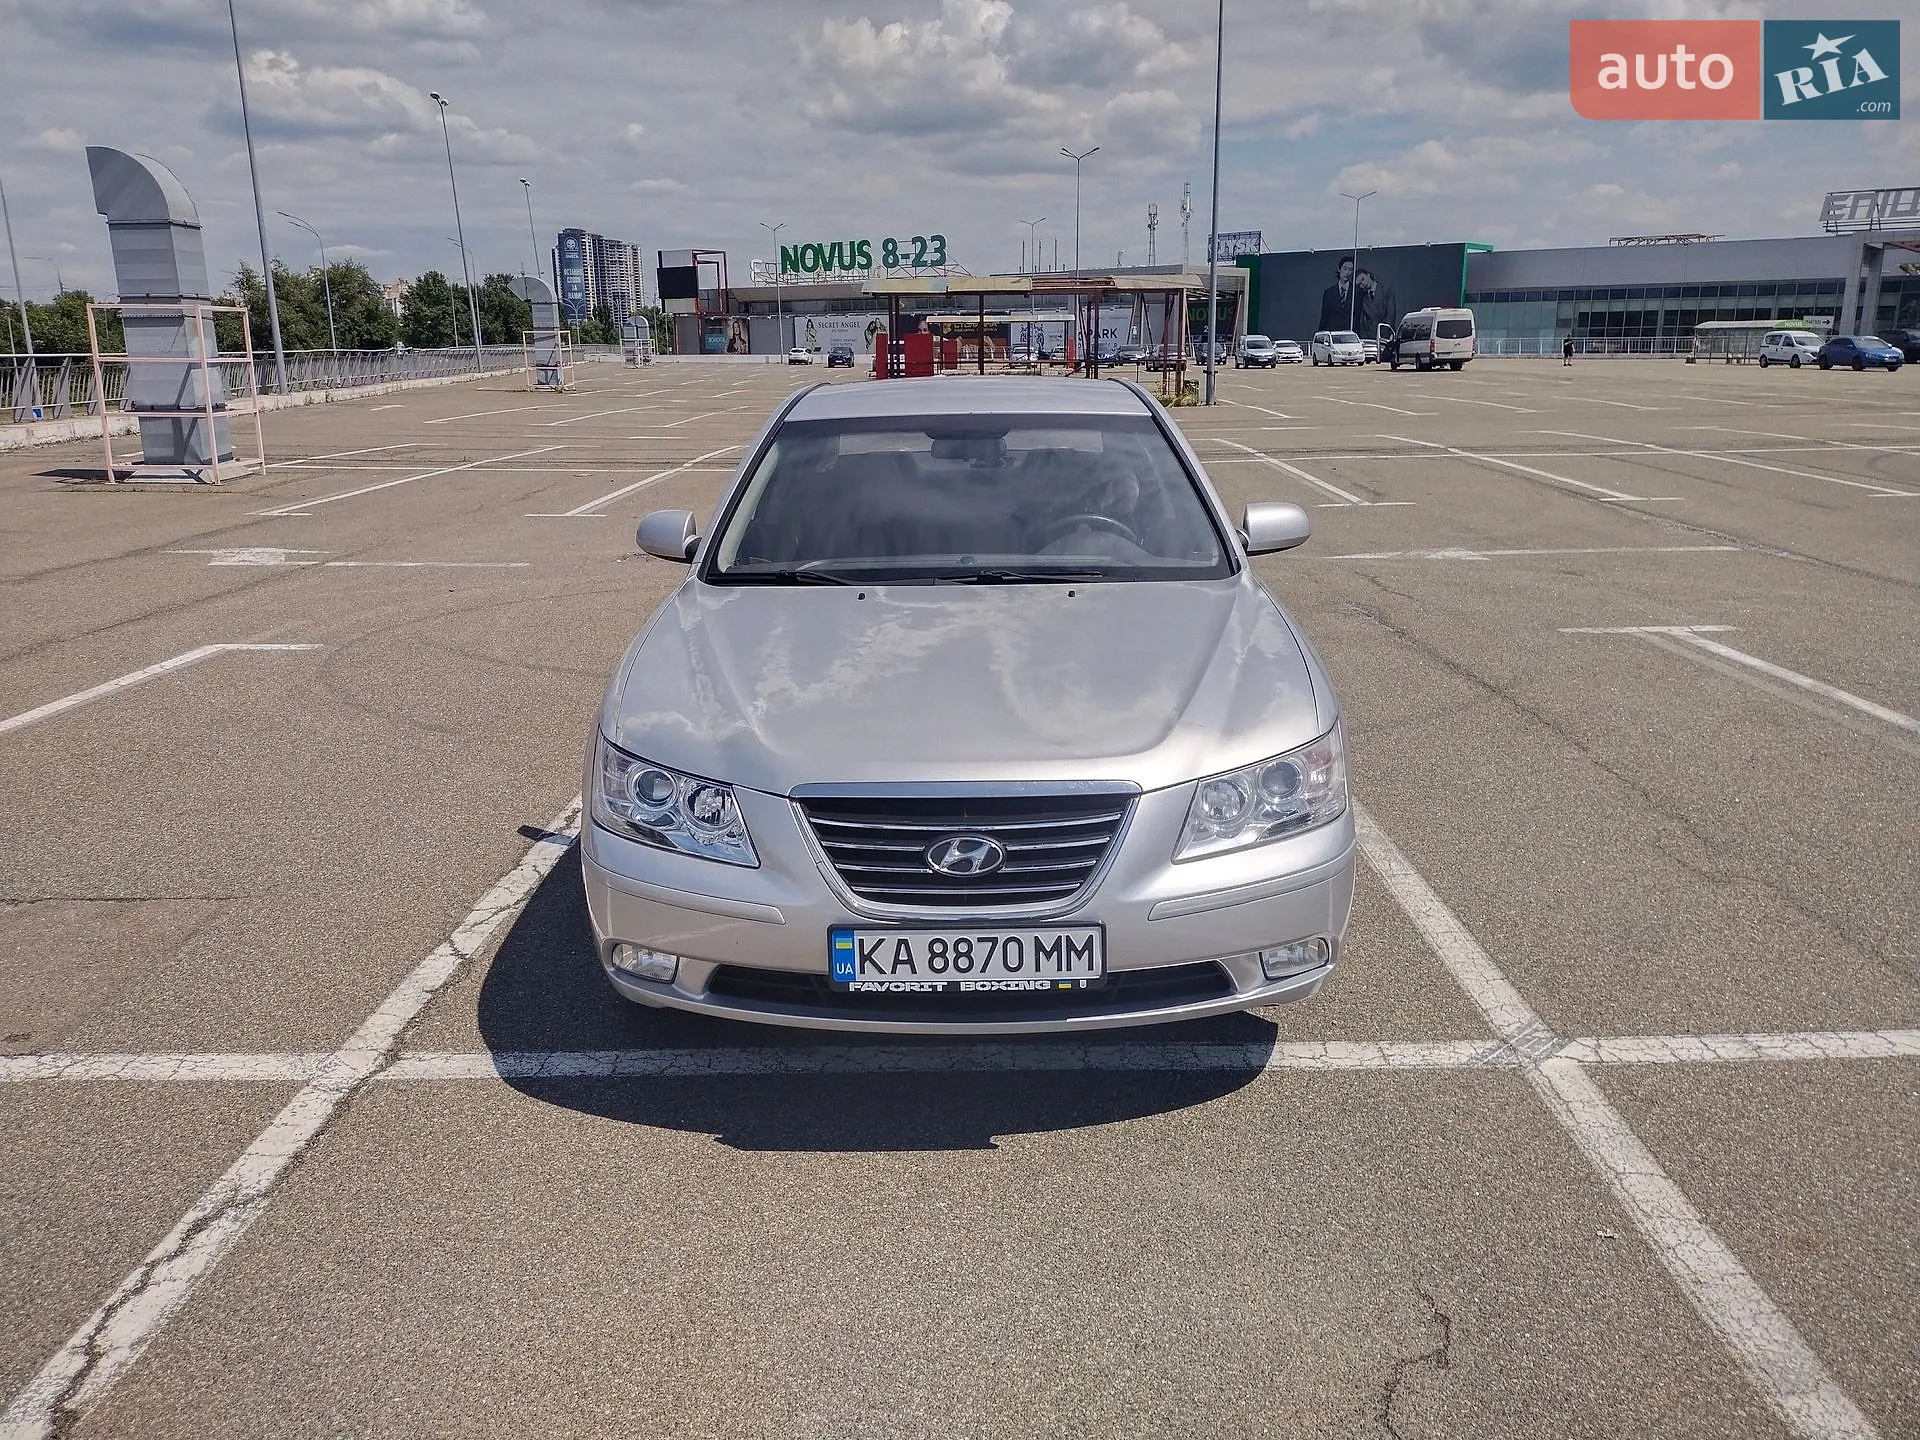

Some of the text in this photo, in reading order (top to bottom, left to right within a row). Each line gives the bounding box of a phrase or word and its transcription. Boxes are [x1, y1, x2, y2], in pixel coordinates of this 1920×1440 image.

[1220, 236, 1260, 256] JYSK
[780, 234, 947, 274] NOVUS 8-23
[1188, 307, 1233, 321] NOUS
[818, 320, 860, 329] SECRET ANGEL
[858, 934, 1094, 975] KA 8870 MM
[836, 963, 853, 975] UA
[849, 980, 1051, 992] FAVORIT BOXING
